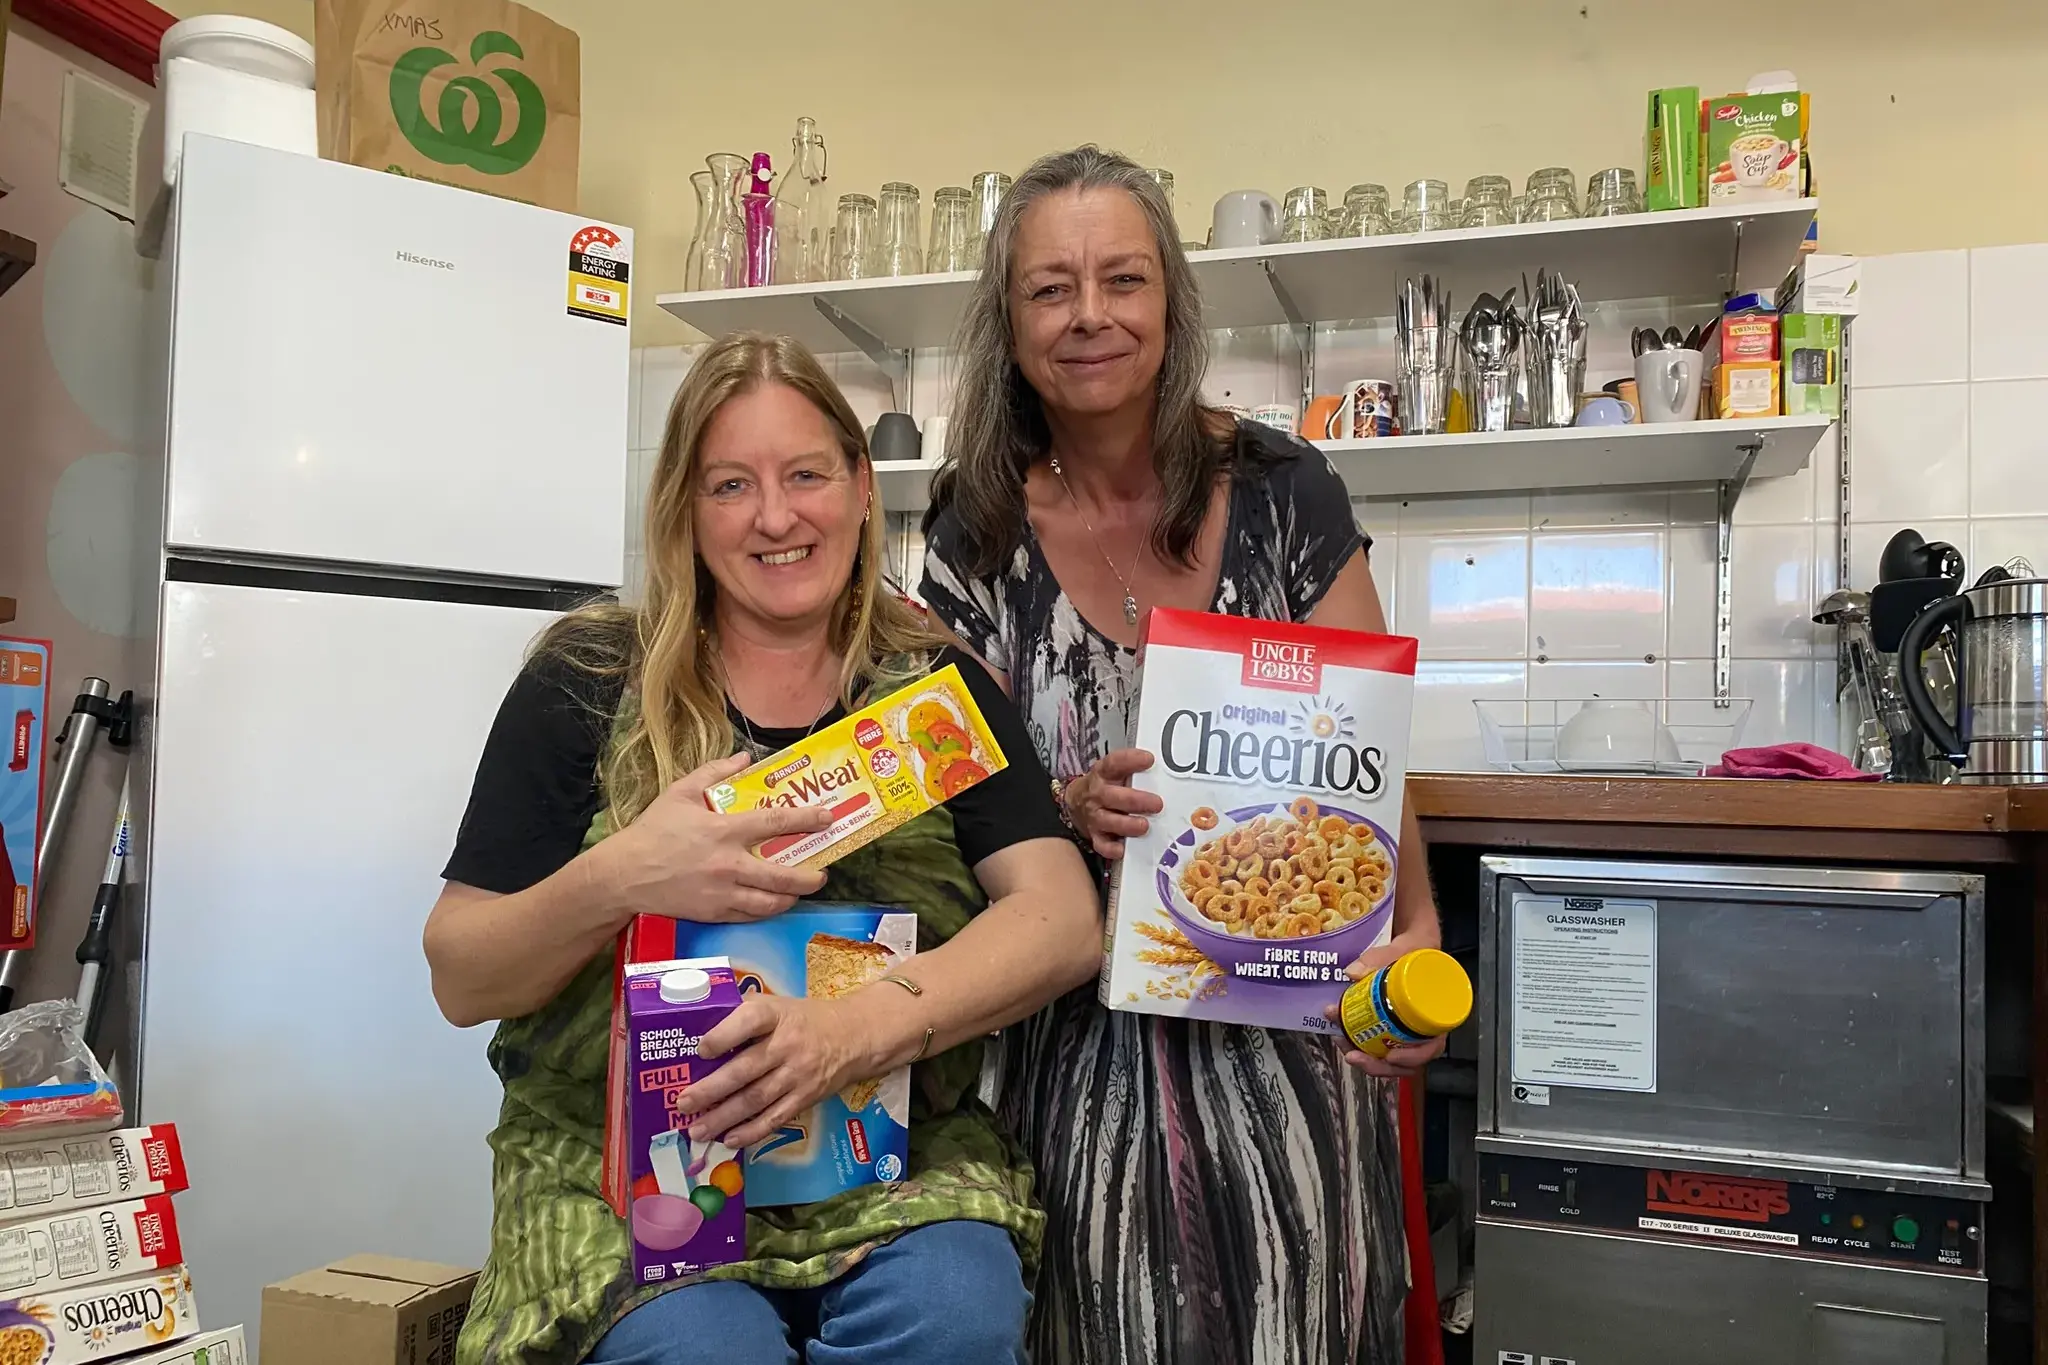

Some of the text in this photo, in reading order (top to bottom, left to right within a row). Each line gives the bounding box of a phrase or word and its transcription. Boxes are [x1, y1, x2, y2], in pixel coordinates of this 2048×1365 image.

[379, 13, 443, 40] XMAS
[1735, 111, 1777, 127] Chicken
[1743, 153, 1772, 169] Soup
[1746, 165, 1769, 177] Cup
[395, 250, 455, 271] Hisense
[581, 255, 617, 270] ENERGY
[581, 264, 616, 279] RATING
[1250, 641, 1316, 666] UNCLE
[1250, 659, 1315, 684] TOBYS
[858, 727, 883, 745] FIBRE
[1161, 709, 1383, 796] Cheerios
[888, 780, 911, 798] 100%
[791, 832, 830, 857] DIGESTIVE
[828, 810, 872, 840] WELL-BEING
[1546, 914, 1626, 927] GLASSWASHER
[1553, 926, 1619, 935] OPERATING INSTRUCTIONS
[1303, 949, 1339, 965] FROM
[1284, 964, 1318, 980] CORN
[1321, 967, 1331, 982] &
[1302, 1015, 1327, 1030] 560g
[639, 1027, 686, 1042] SCHOOL
[640, 1035, 703, 1052] BREAKFAST
[640, 1046, 678, 1062] CLUBS
[643, 1067, 688, 1089] FULL
[109, 1135, 131, 1192] Cheerios
[147, 1142, 161, 1178] TOBYS
[155, 1140, 171, 1176] UNCLE
[1563, 1166, 1578, 1174] HOT
[1538, 1183, 1560, 1193] RINSE
[1646, 1169, 1791, 1216] NORRIS
[1490, 1199, 1517, 1208] POWER
[1559, 1206, 1580, 1215] COLD
[140, 1215, 155, 1253] TOBYS
[148, 1213, 165, 1250] UNCLE
[726, 1235, 736, 1243] 1L
[1640, 1219, 1654, 1227] E17
[1659, 1221, 1672, 1229] 700
[1672, 1223, 1699, 1232] SERIES
[1714, 1228, 1743, 1238] DELUXE
[1742, 1230, 1796, 1243] GLASSWASHER
[99, 1210, 121, 1270] Cheerios
[1811, 1235, 1839, 1245] READY
[1843, 1238, 1870, 1248] CYCLE
[1890, 1241, 1916, 1250] START
[1938, 1256, 1962, 1265] MODE
[1939, 1248, 1961, 1257] TEST
[64, 1286, 164, 1332] Cheerios
